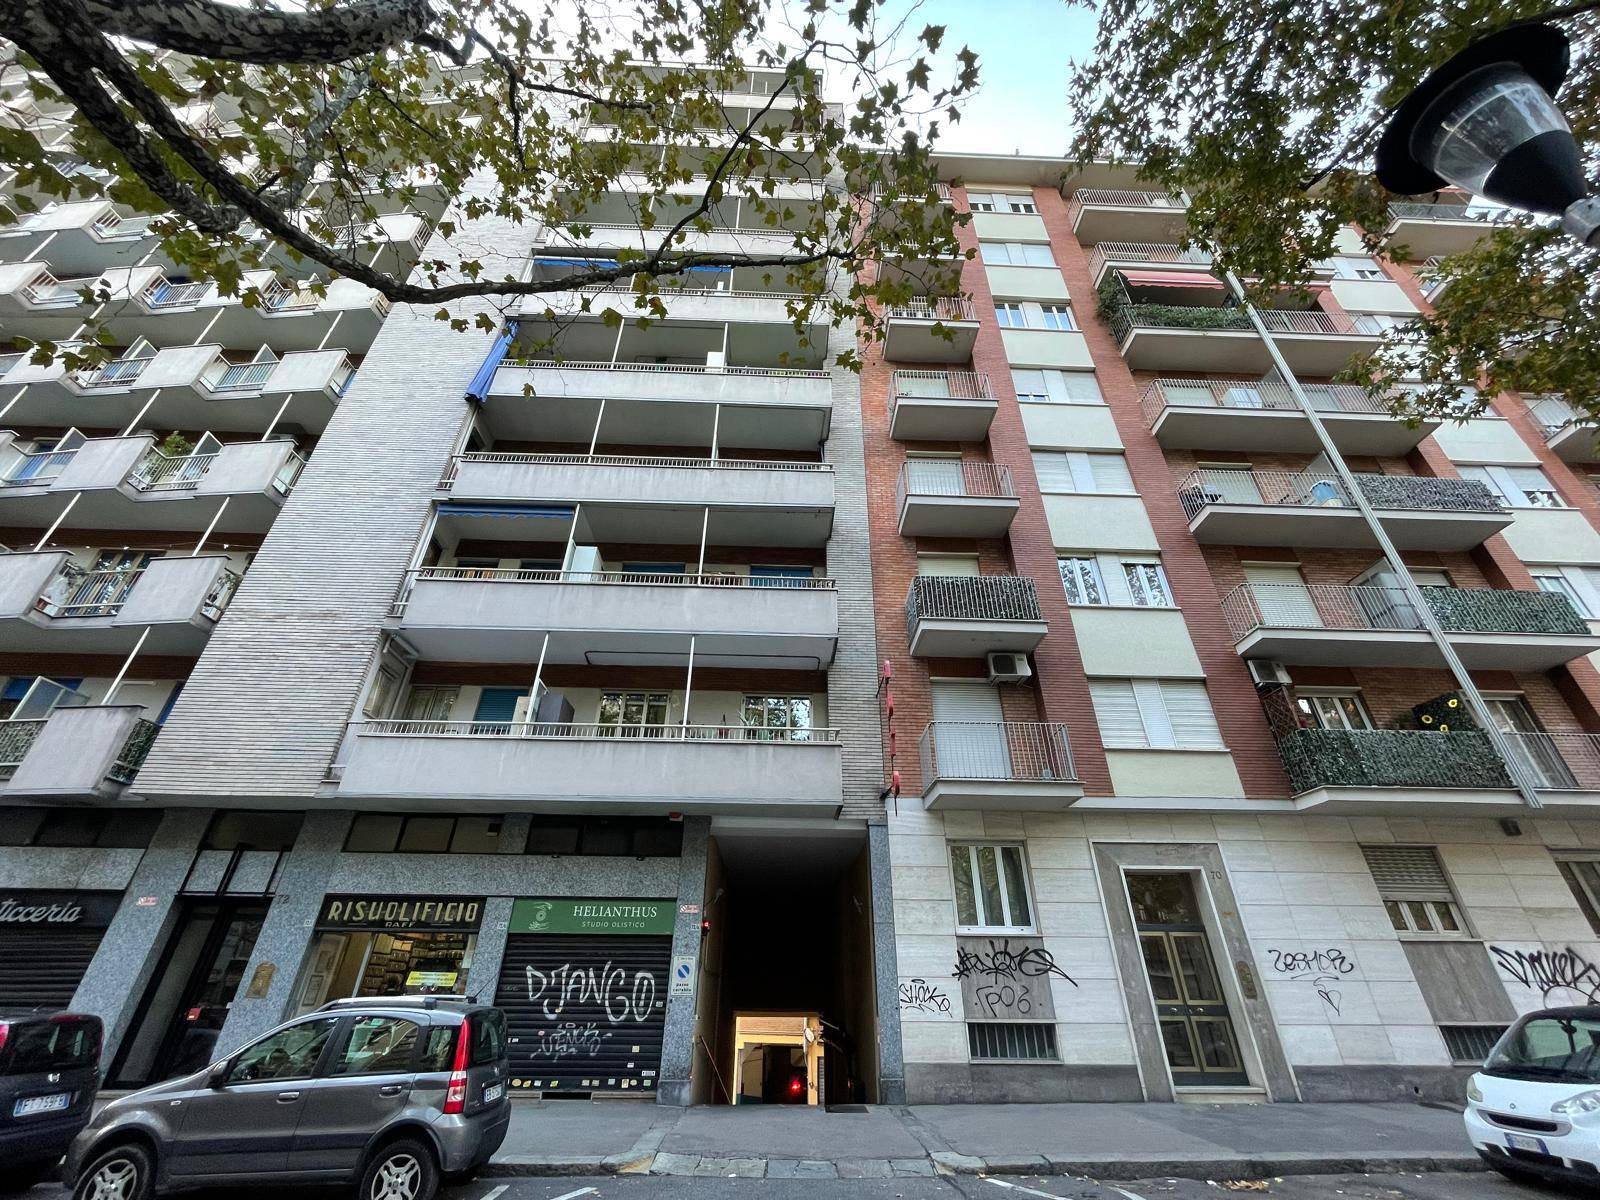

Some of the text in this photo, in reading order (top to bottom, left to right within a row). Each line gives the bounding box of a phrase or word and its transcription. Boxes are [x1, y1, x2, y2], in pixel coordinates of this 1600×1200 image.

[1210, 870, 1222, 880] 70
[328, 901, 478, 922] RISUOLIFICIO
[573, 905, 657, 918] HELIANTHUS
[526, 960, 655, 1025] DJANGO
